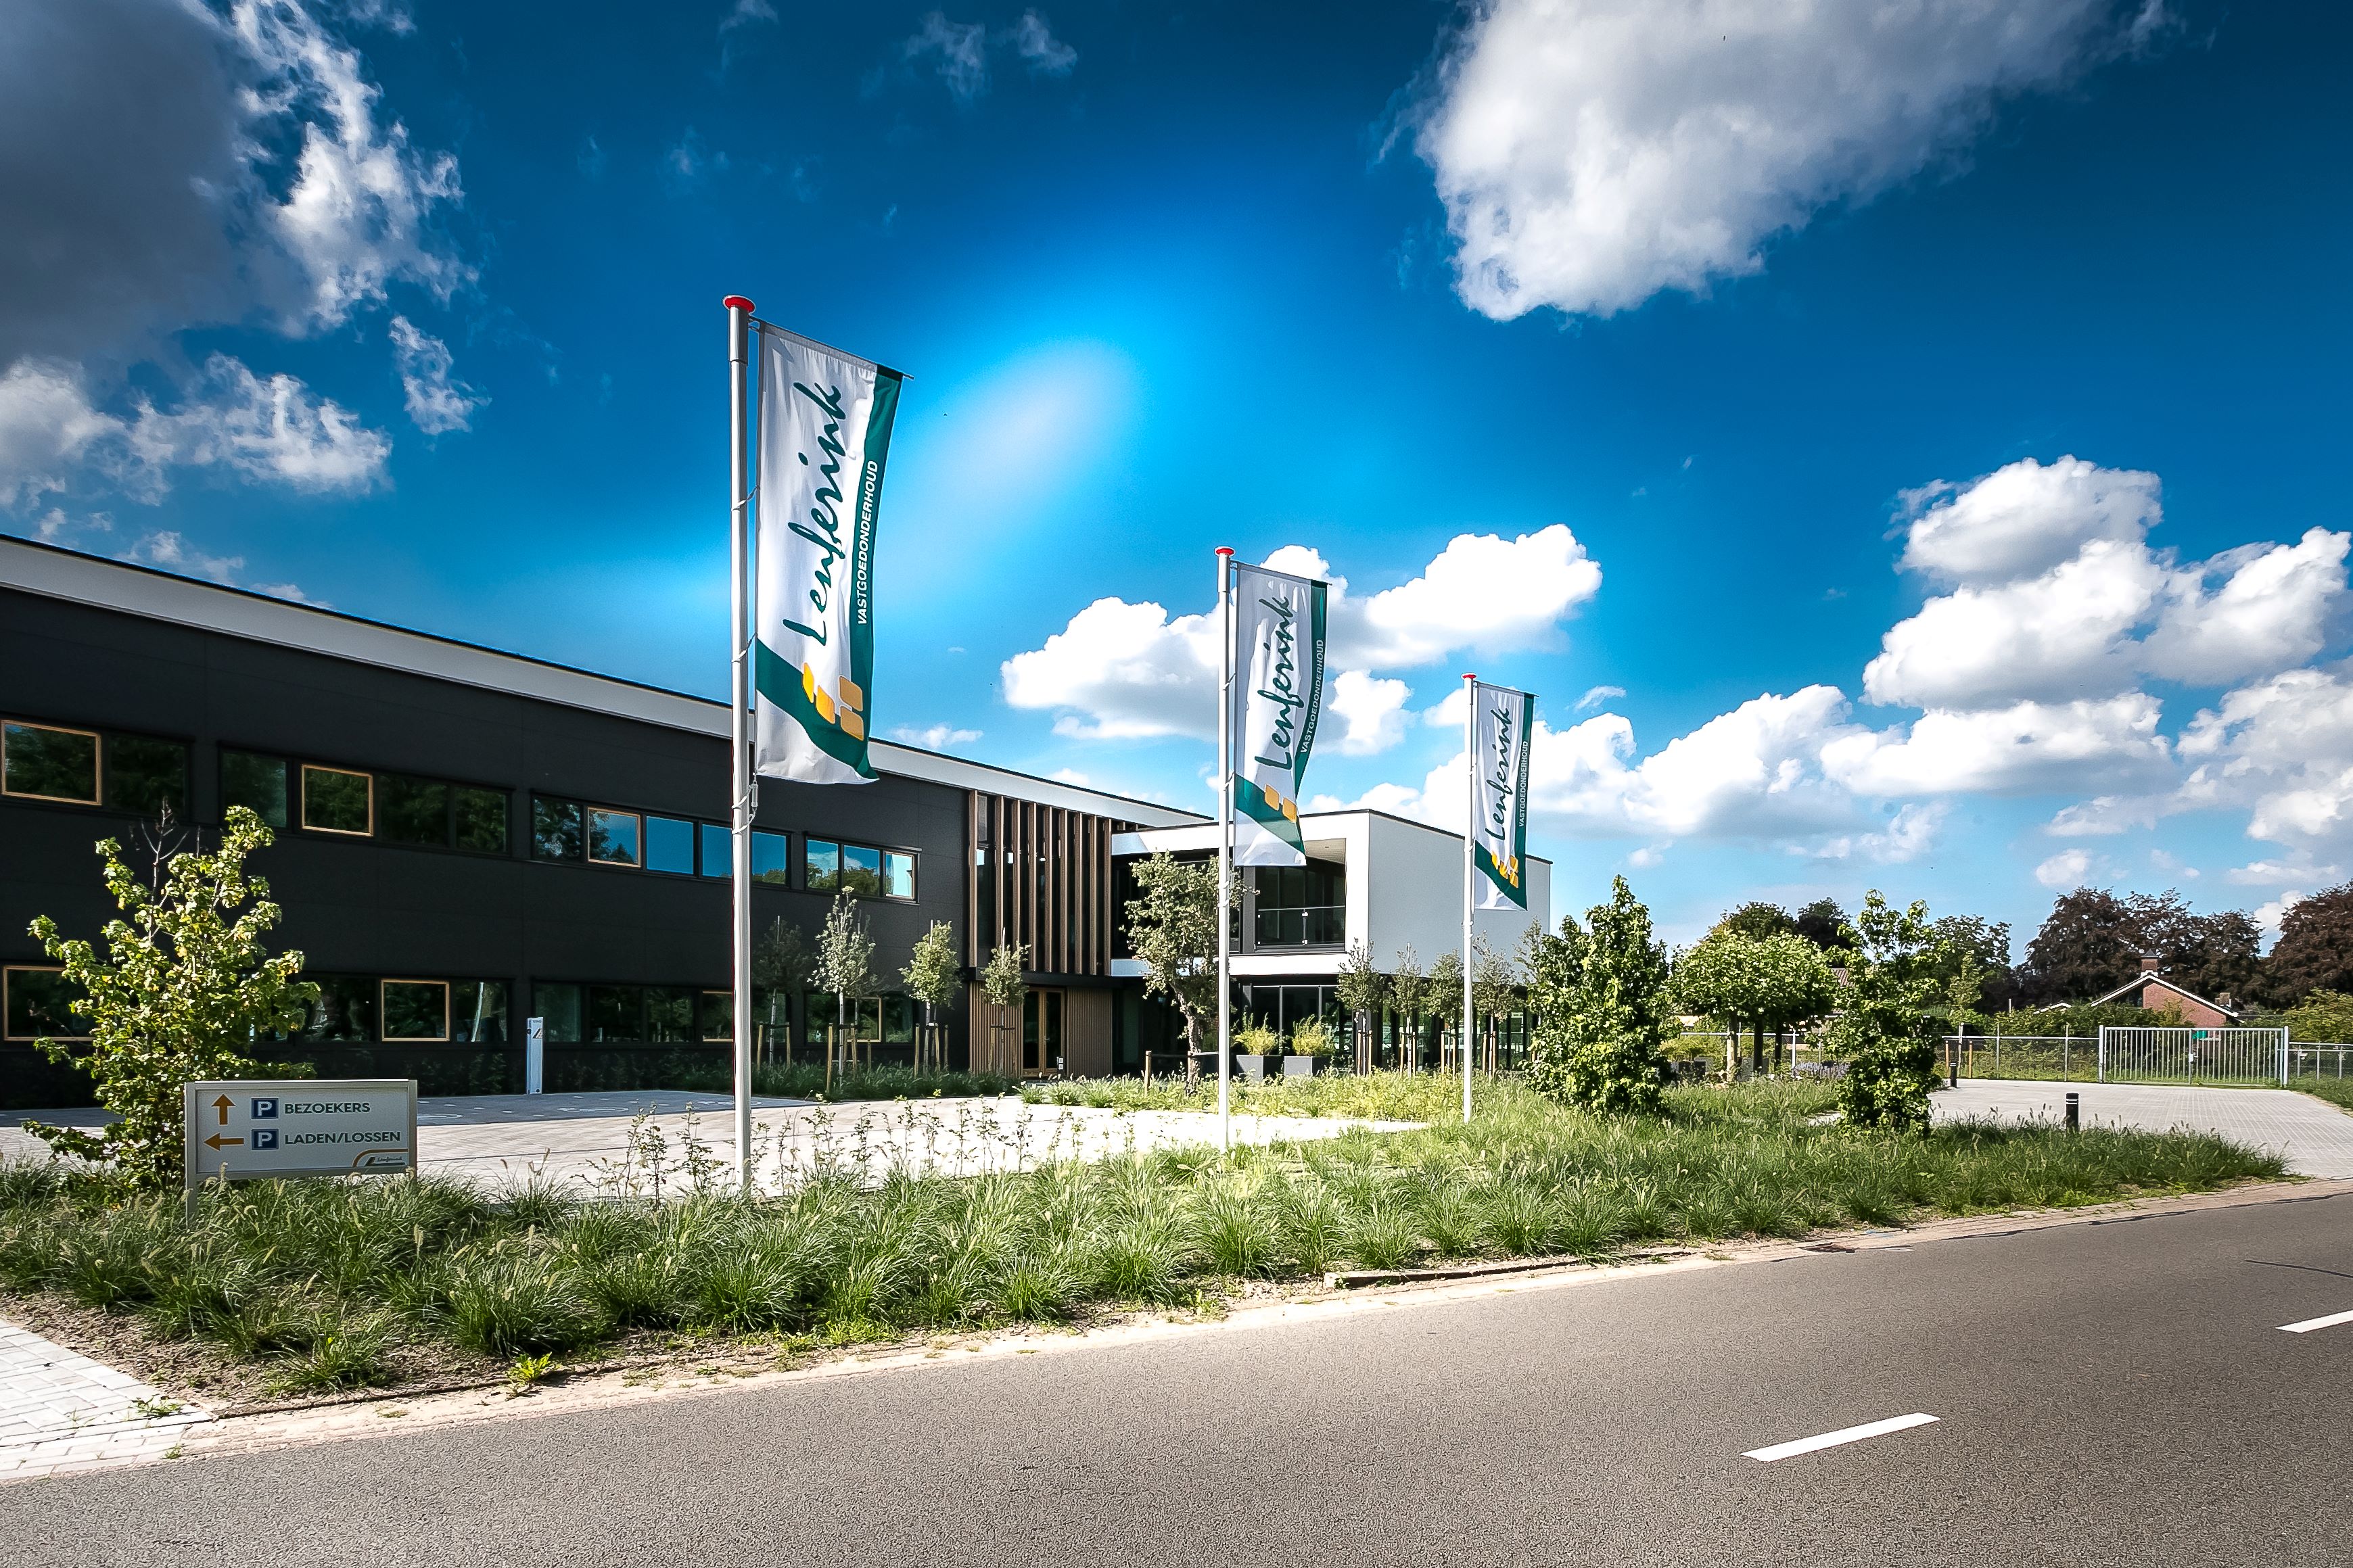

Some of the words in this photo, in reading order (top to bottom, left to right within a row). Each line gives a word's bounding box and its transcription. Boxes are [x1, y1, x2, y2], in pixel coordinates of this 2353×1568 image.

[783, 382, 846, 646] Lenferink
[857, 460, 878, 625] VASTGOEDONDERHOUD
[1255, 596, 1304, 770] Lenferink
[1301, 640, 1324, 753] VASTGOEDONDERHOUD
[1485, 708, 1513, 840] Lenferink
[1518, 741, 1528, 827] VASTGOEDONDERHOUD
[258, 1101, 272, 1116] P
[284, 1103, 371, 1114] BEZOEKERS
[258, 1132, 272, 1147] P
[285, 1131, 400, 1144] LADEN/LOSSEN
